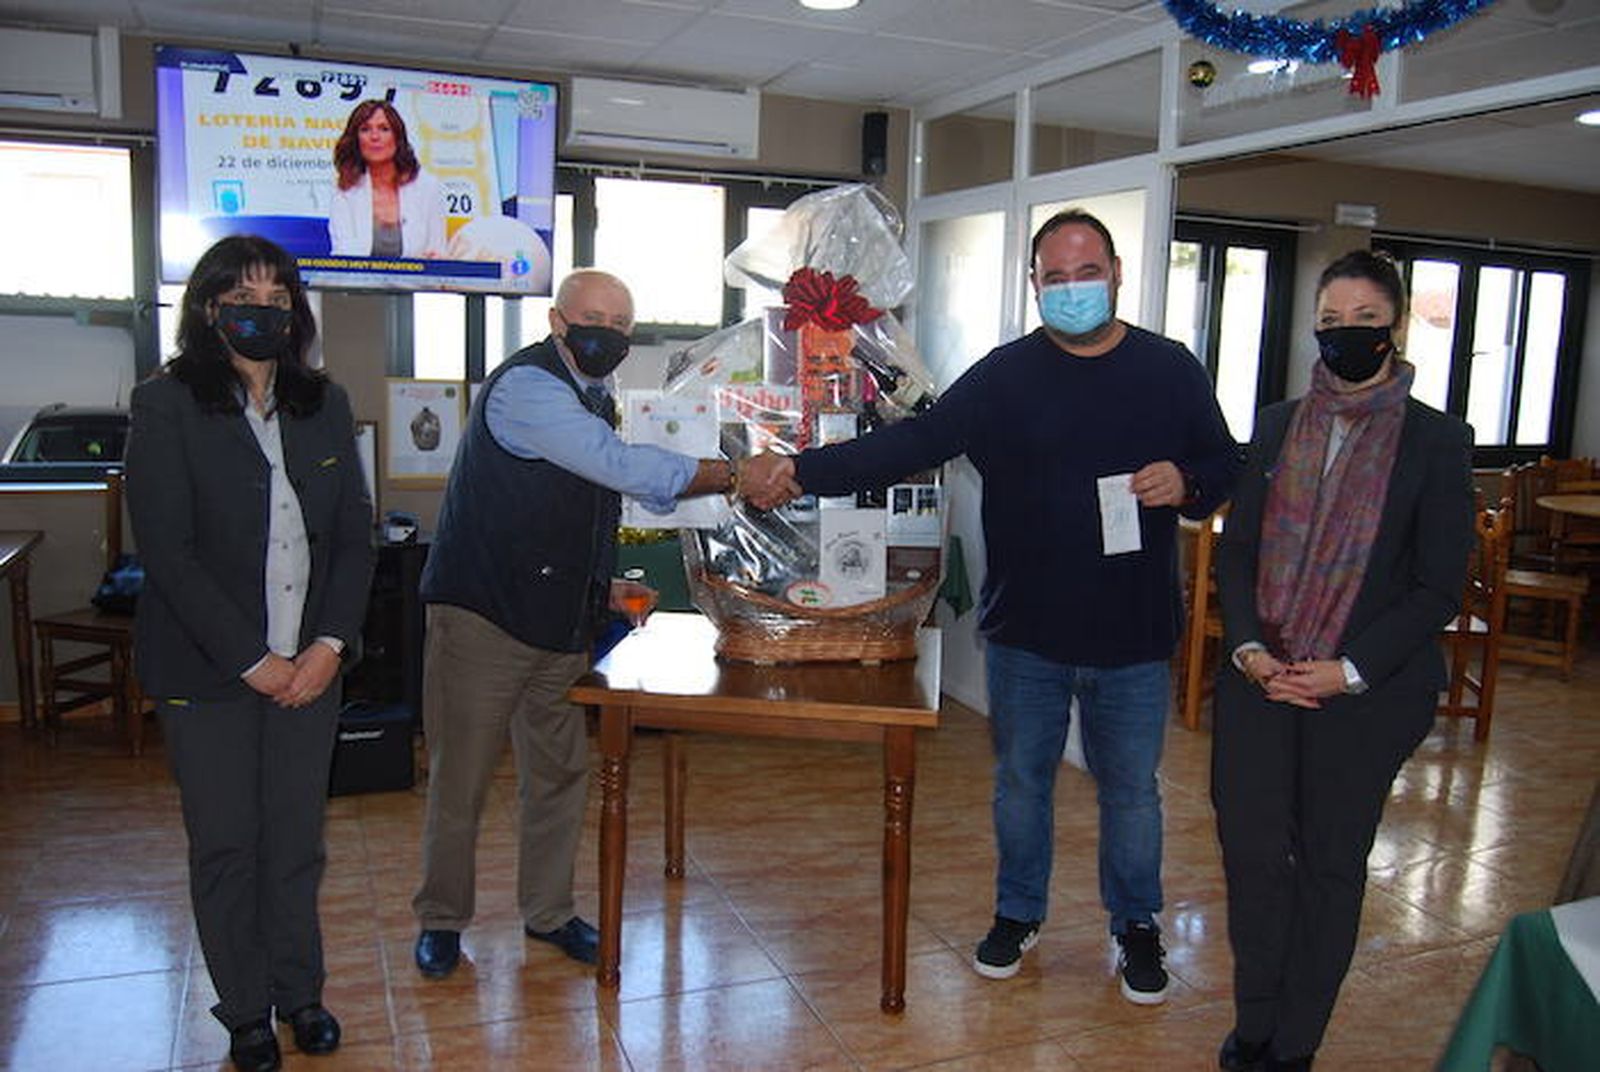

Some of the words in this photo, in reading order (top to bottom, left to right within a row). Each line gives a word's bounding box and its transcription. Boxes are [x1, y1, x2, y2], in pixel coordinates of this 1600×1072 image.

[197, 113, 296, 129] LOTERIA
[242, 134, 269, 149] DE
[217, 154, 237, 169] 22
[241, 154, 263, 169] de
[446, 193, 472, 214] 20
